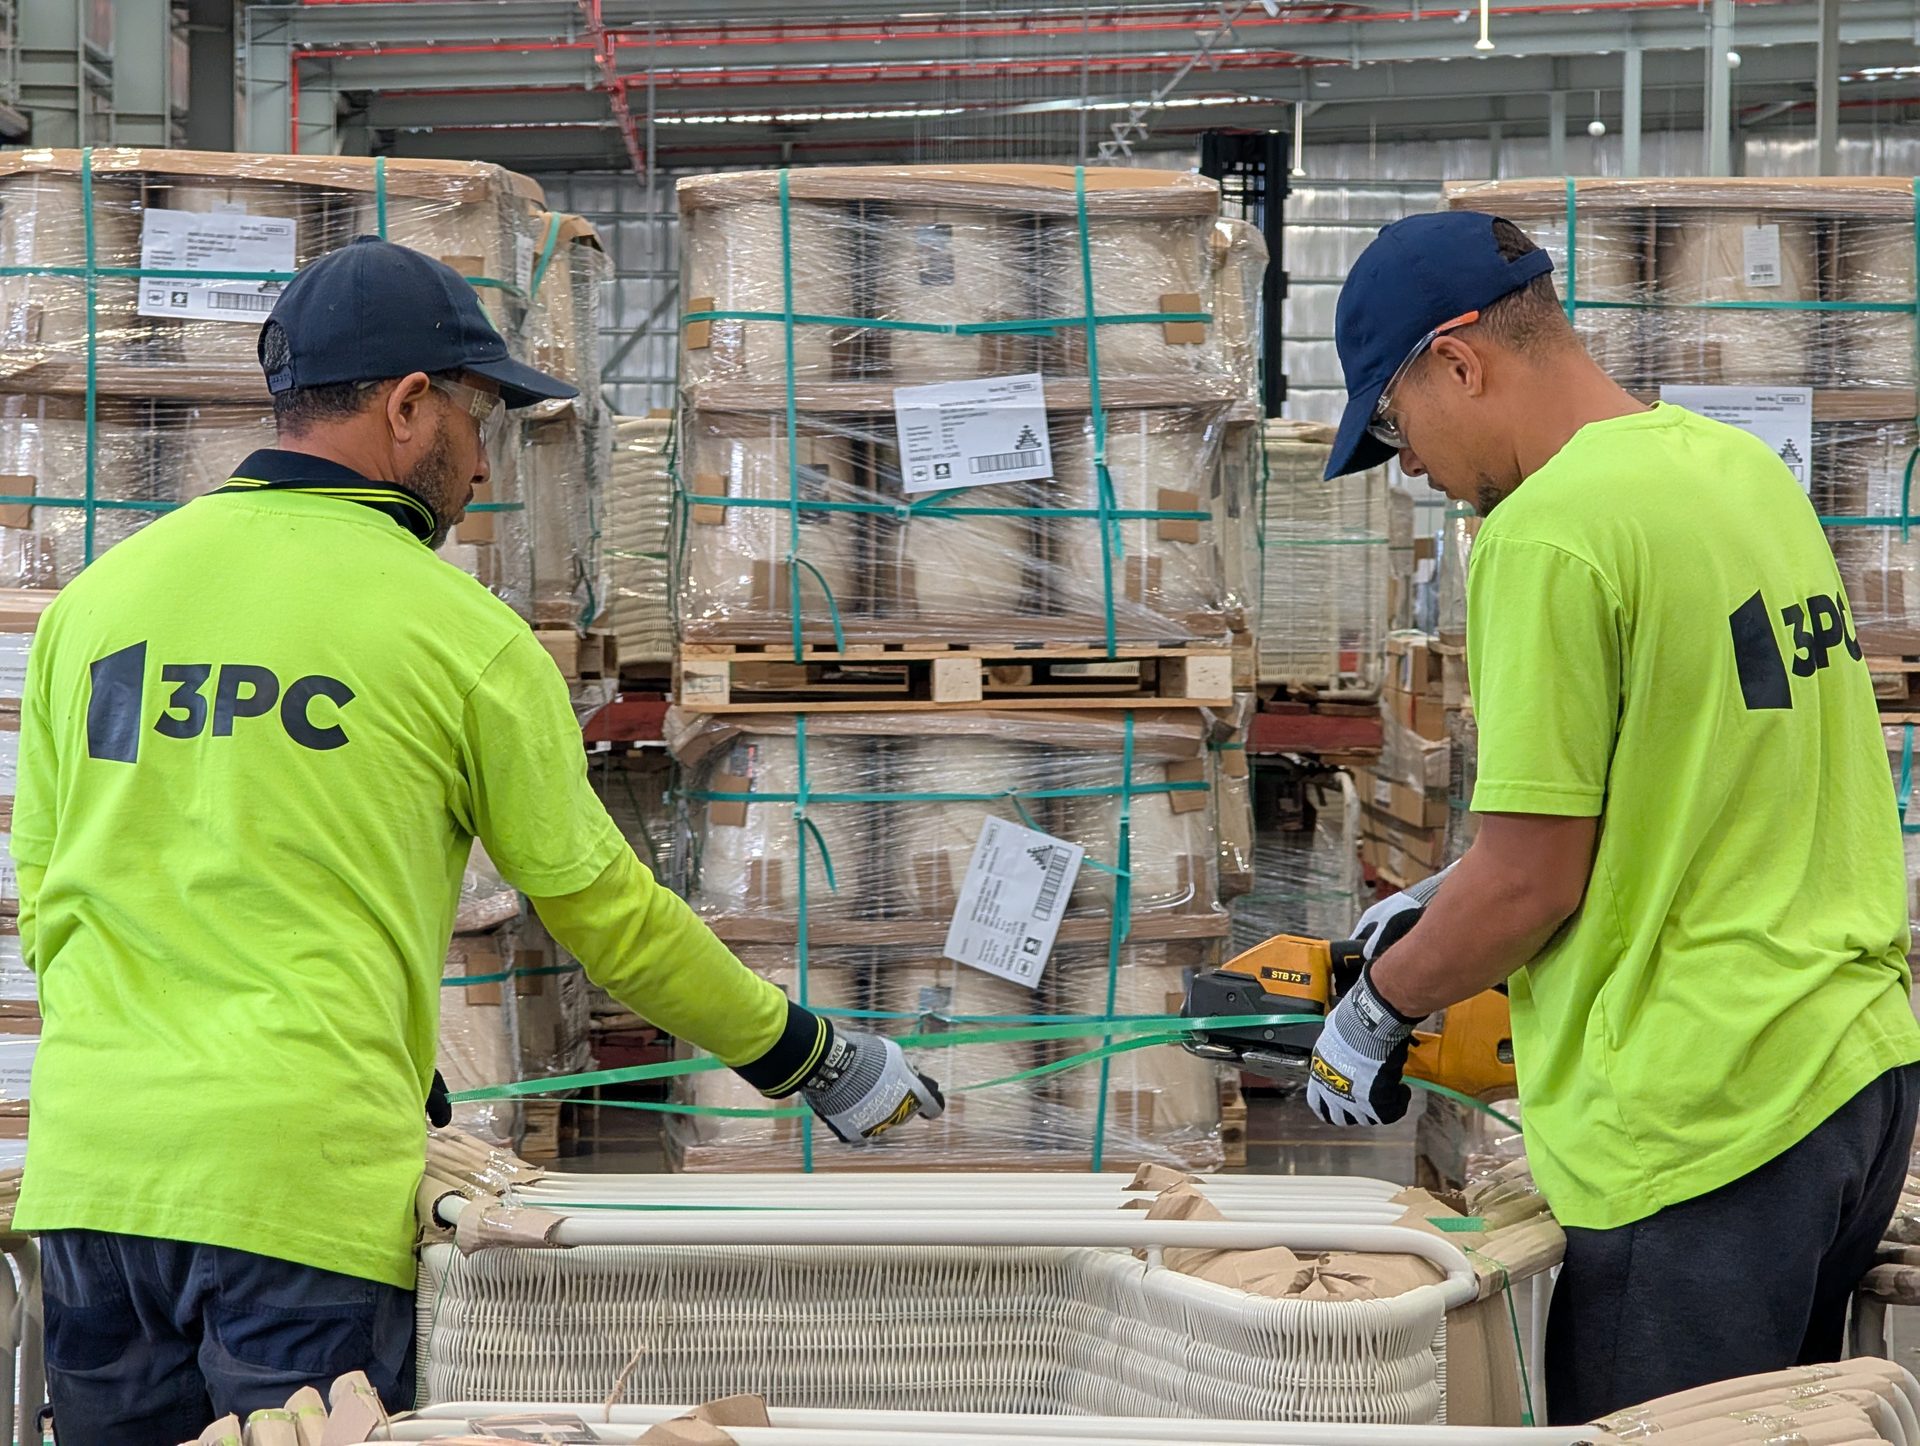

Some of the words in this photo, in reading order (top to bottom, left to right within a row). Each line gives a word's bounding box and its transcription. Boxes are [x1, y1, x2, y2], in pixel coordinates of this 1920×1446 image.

[153, 663, 357, 752] 3PC
[1271, 970, 1289, 981] STB
[1291, 973, 1301, 982] 73
